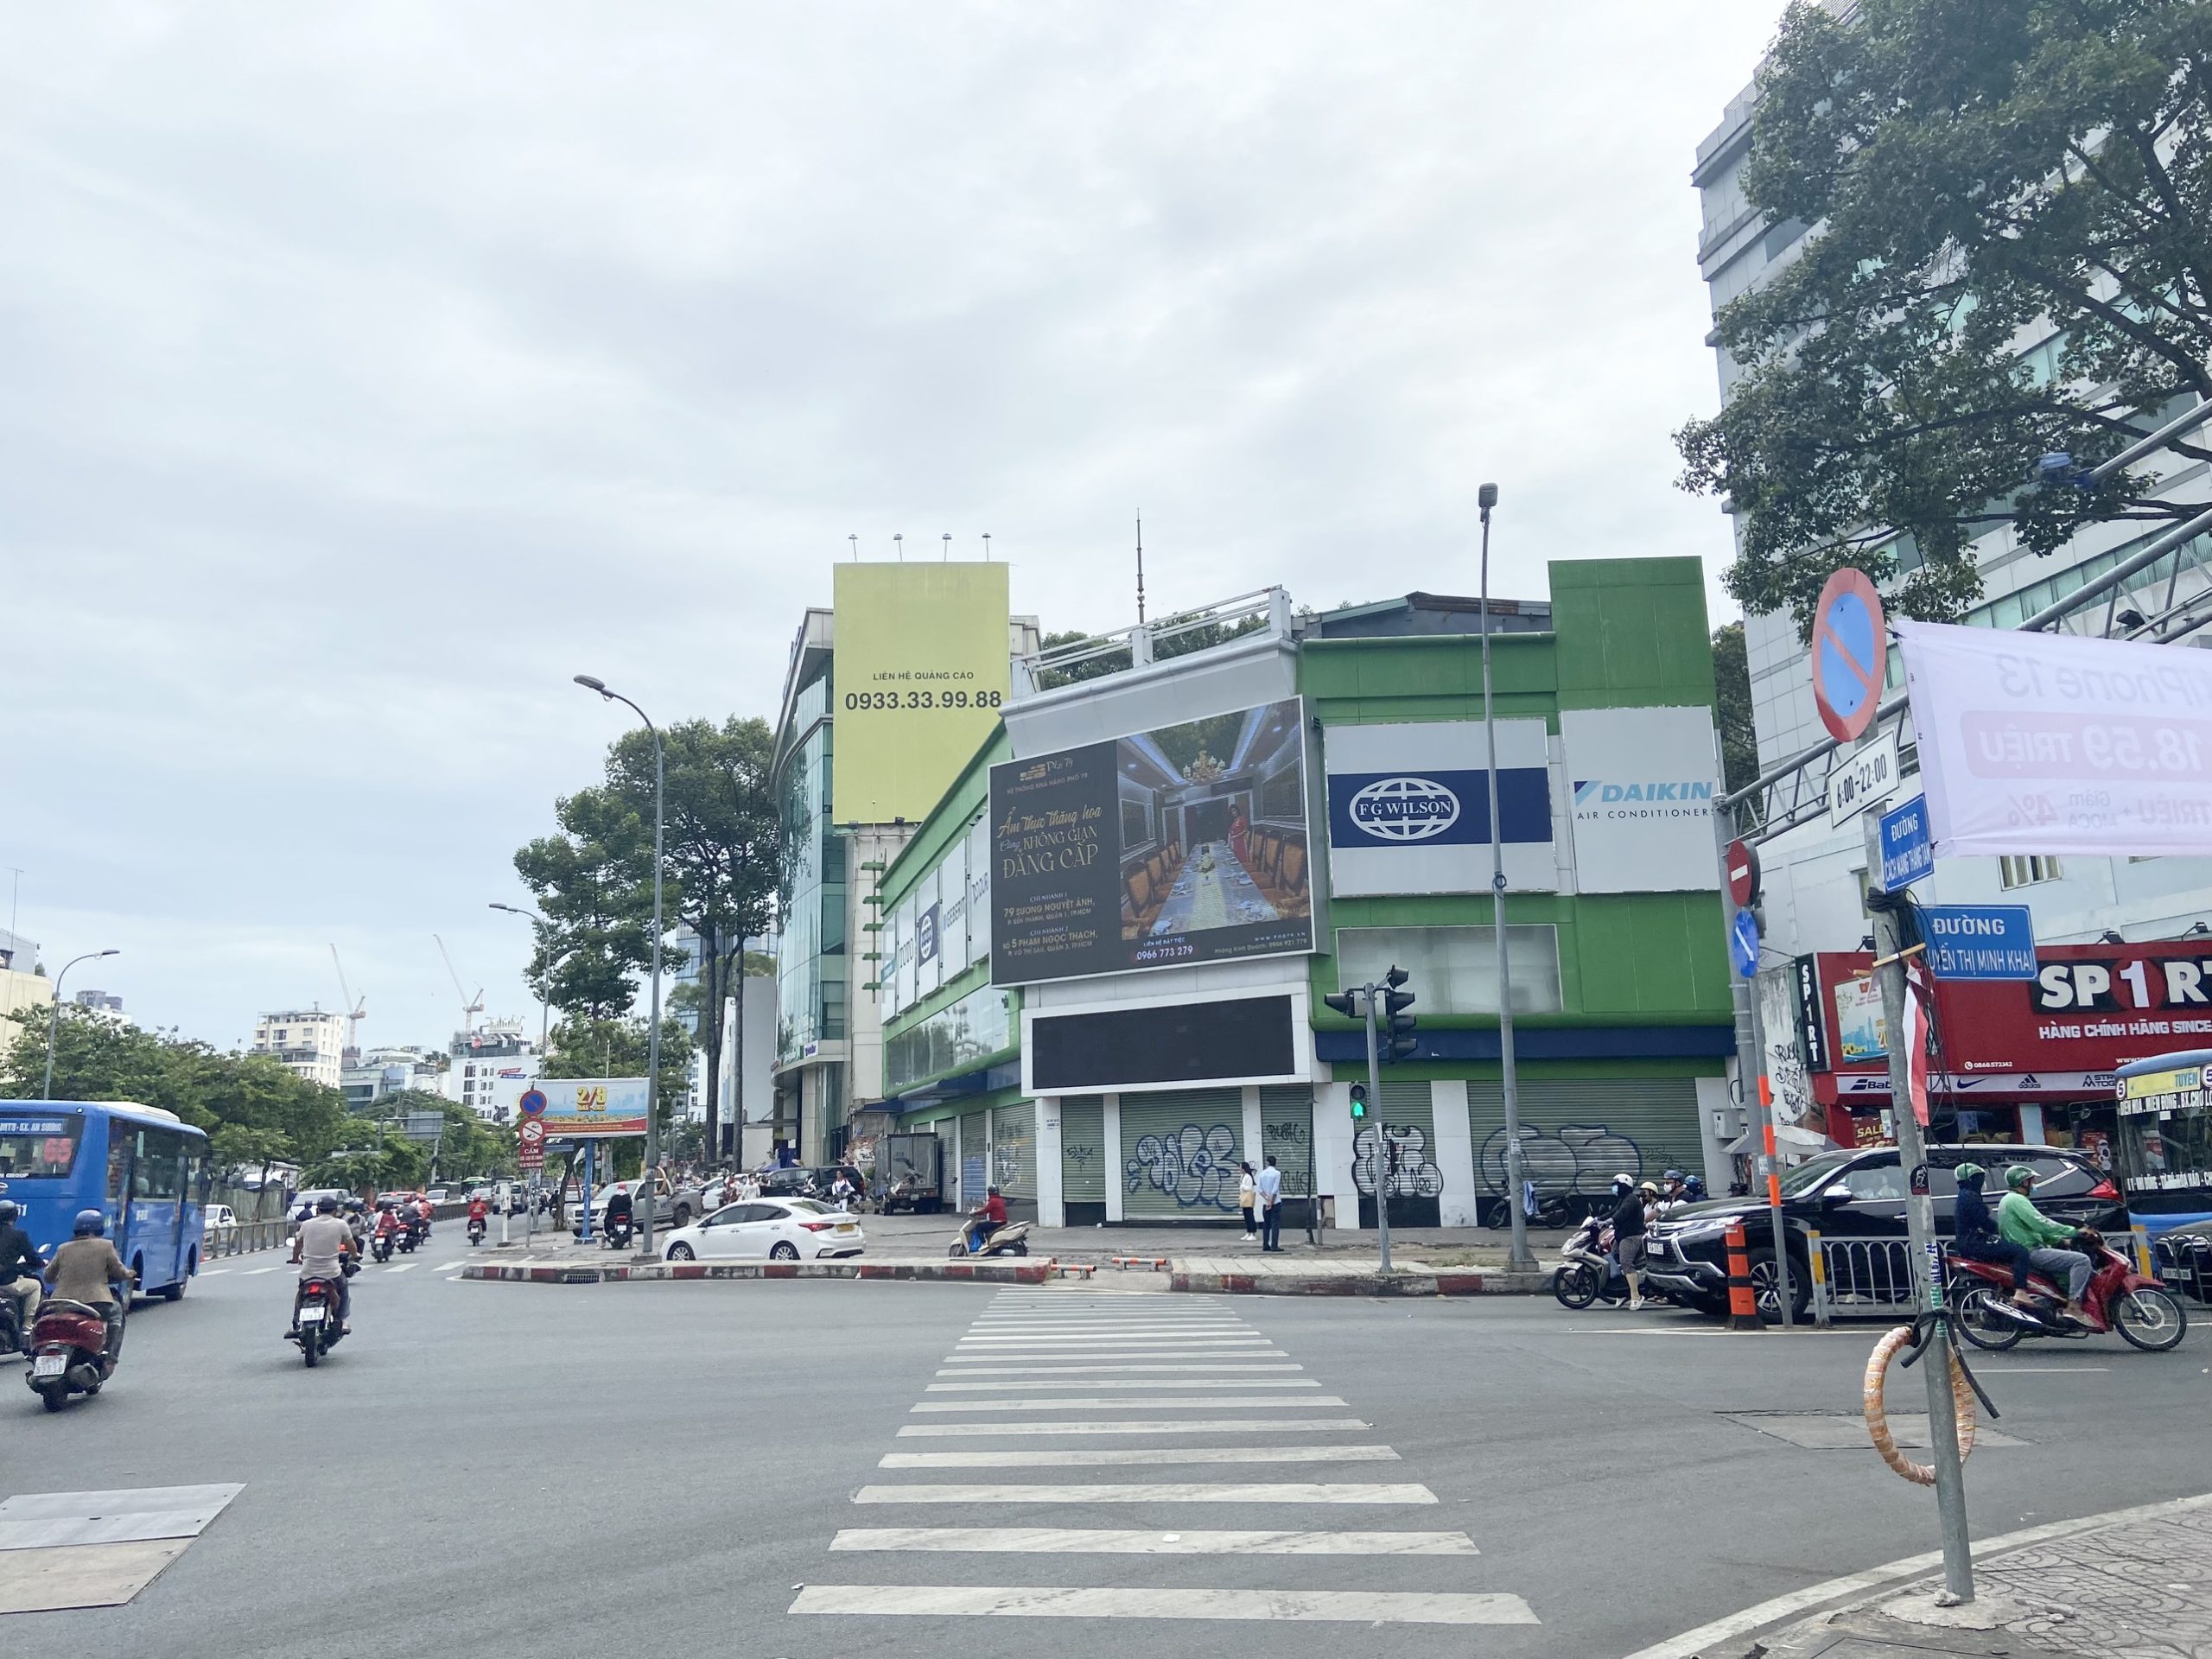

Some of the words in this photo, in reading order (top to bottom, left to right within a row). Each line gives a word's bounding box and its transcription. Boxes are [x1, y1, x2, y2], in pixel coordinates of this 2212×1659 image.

[845, 690, 1001, 709] 0933.33.99.88
[1601, 781, 1713, 803] DAIKIN
[1083, 804, 1103, 820] hoa
[1386, 800, 1452, 815] WILSON
[1577, 810, 1599, 820] AIR
[1891, 813, 1918, 842] ĐƯỜNG
[1003, 907, 1014, 918] 79
[1932, 914, 2005, 935] ĐƯỜNG
[1012, 938, 1017, 949] 5
[1136, 948, 1157, 961] 0966
[1160, 946, 1175, 958] 773
[1177, 944, 1193, 957] 279
[1957, 950, 1976, 976] THỊ
[1977, 950, 2005, 971] MINH
[2007, 950, 2034, 971] KHAI
[2039, 1020, 2081, 1039] HÀNG
[2084, 1019, 2126, 1038] CHÍNH
[2129, 1019, 2170, 1035] HÃNG
[2172, 1020, 2212, 1033] SINCE
[576, 1084, 607, 1106] 2/9
[1857, 1124, 1884, 1138] SALE
[524, 1146, 539, 1154] CẤM
